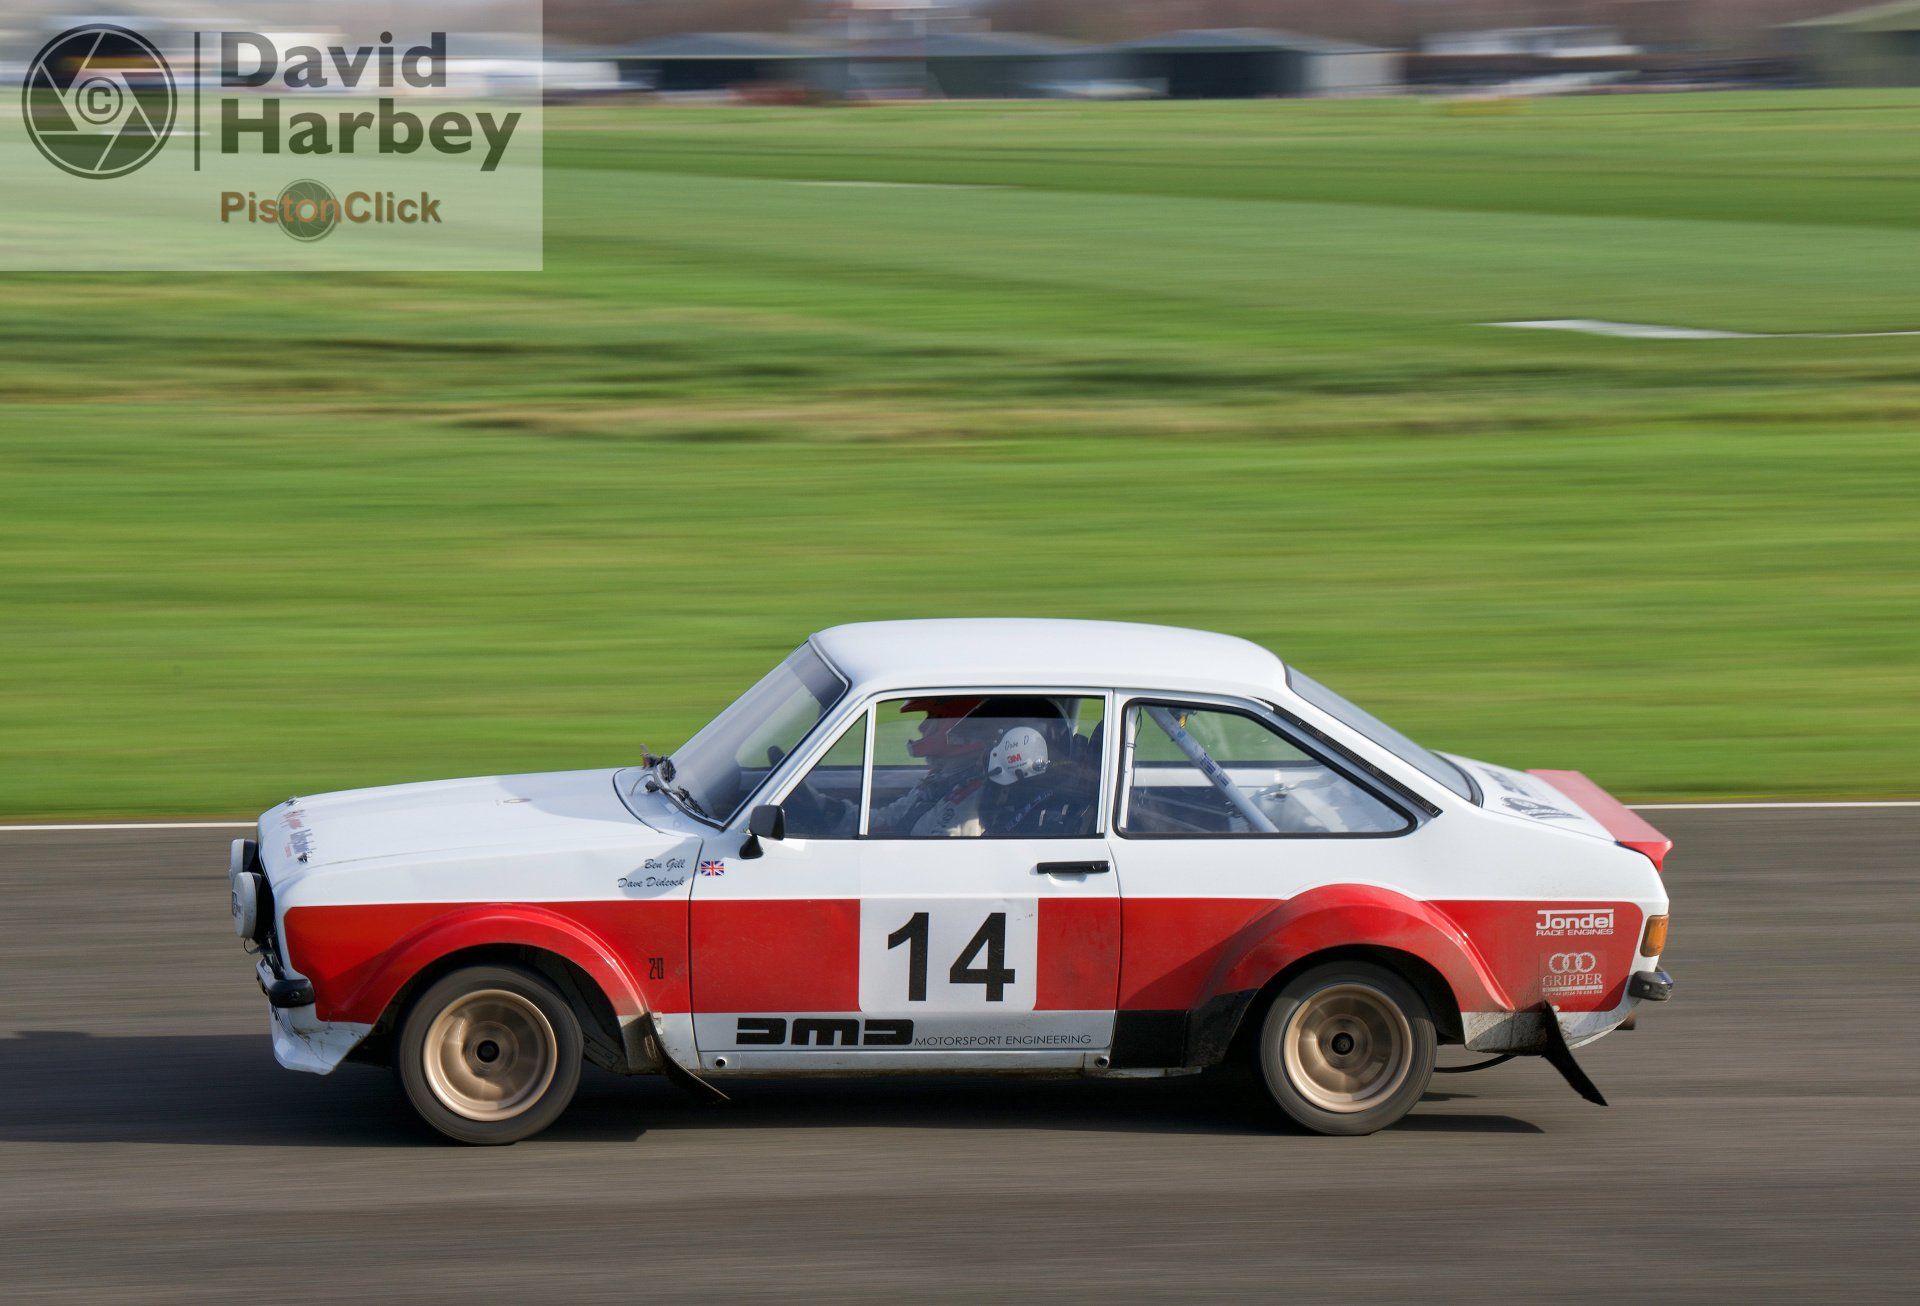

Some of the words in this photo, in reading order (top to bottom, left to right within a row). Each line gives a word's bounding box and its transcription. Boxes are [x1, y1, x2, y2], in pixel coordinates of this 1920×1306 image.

[1007, 753, 1022, 763] 3M
[644, 858, 662, 869] Ben
[666, 858, 686, 872] Gill
[617, 877, 643, 888] Dave
[646, 876, 685, 887] Didcock
[1536, 908, 1614, 930] Jondel
[887, 912, 1016, 1002] 14
[649, 957, 664, 979] 20
[1542, 973, 1603, 986] GRIPPER
[914, 1036, 1002, 1046] MOTORSPORT
[1005, 1034, 1092, 1045] ENGINEERING
